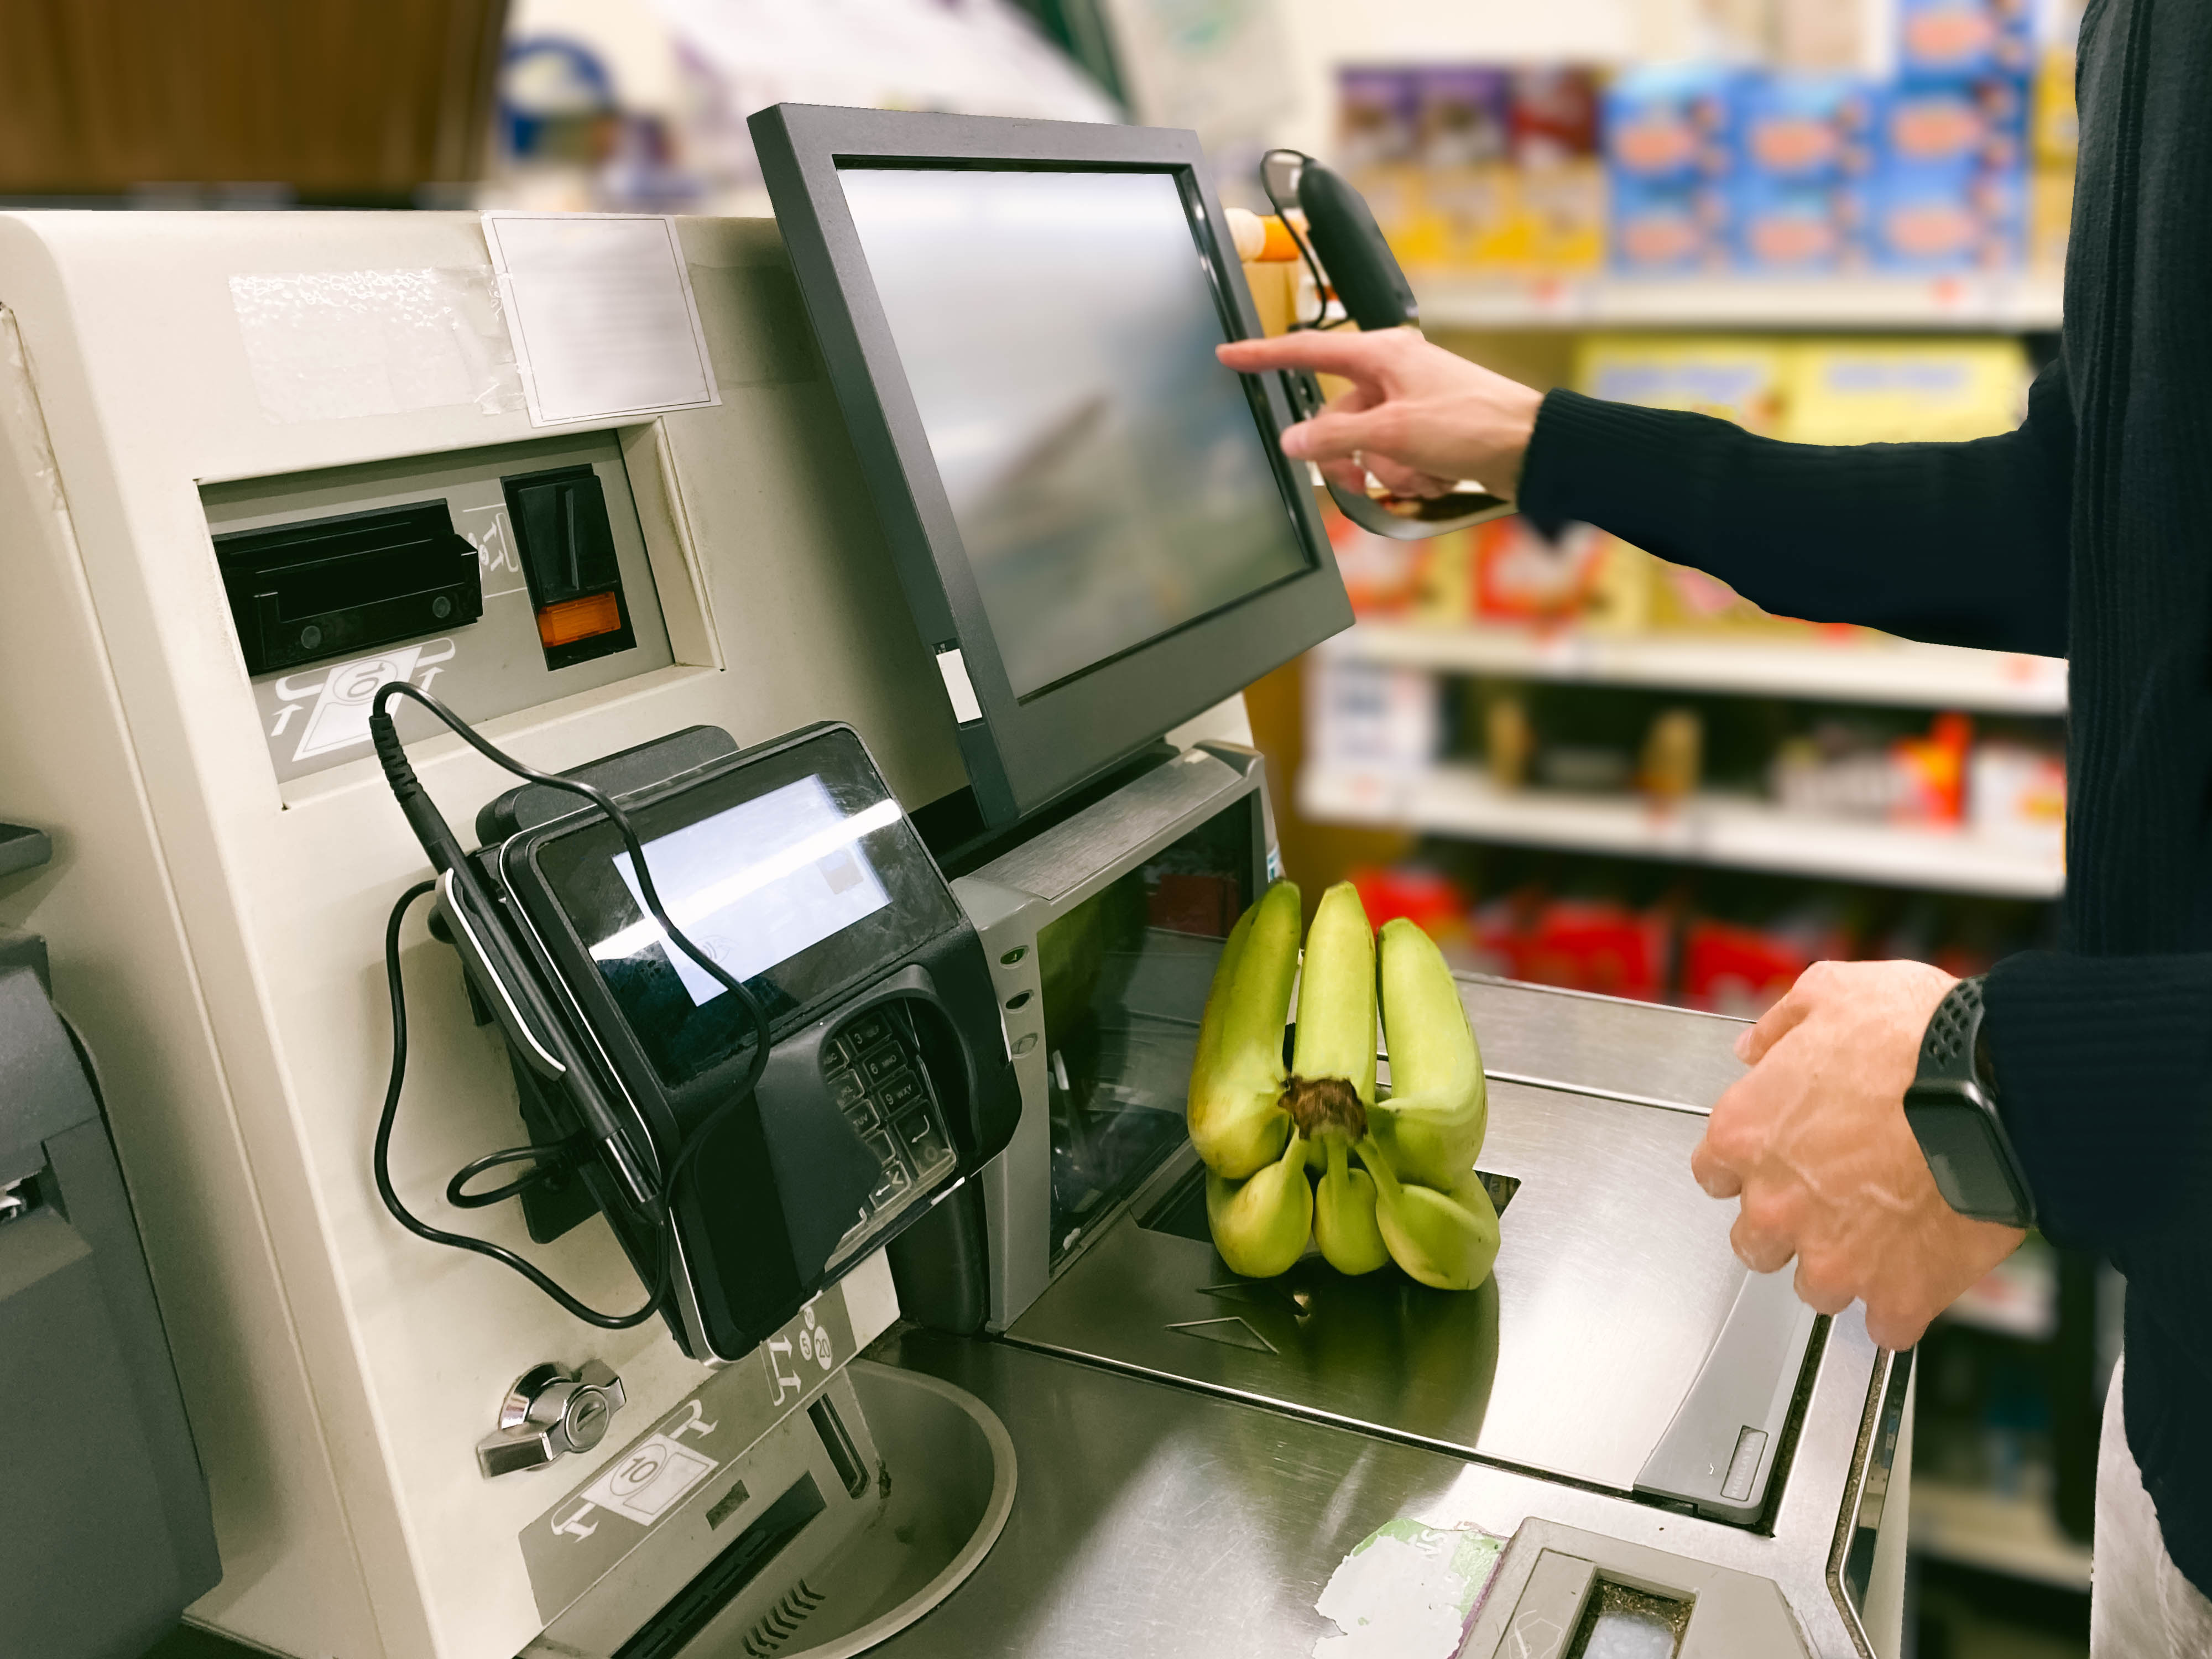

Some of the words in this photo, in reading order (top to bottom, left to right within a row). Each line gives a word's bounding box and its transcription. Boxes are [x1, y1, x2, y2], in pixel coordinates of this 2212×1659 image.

[347, 662, 386, 698] 10
[854, 1032, 863, 1045] 3
[869, 1063, 878, 1074] 6
[885, 1093, 894, 1105] 9
[801, 1338, 810, 1355] 5
[816, 1338, 831, 1358] 20
[620, 1457, 658, 1483] 10
